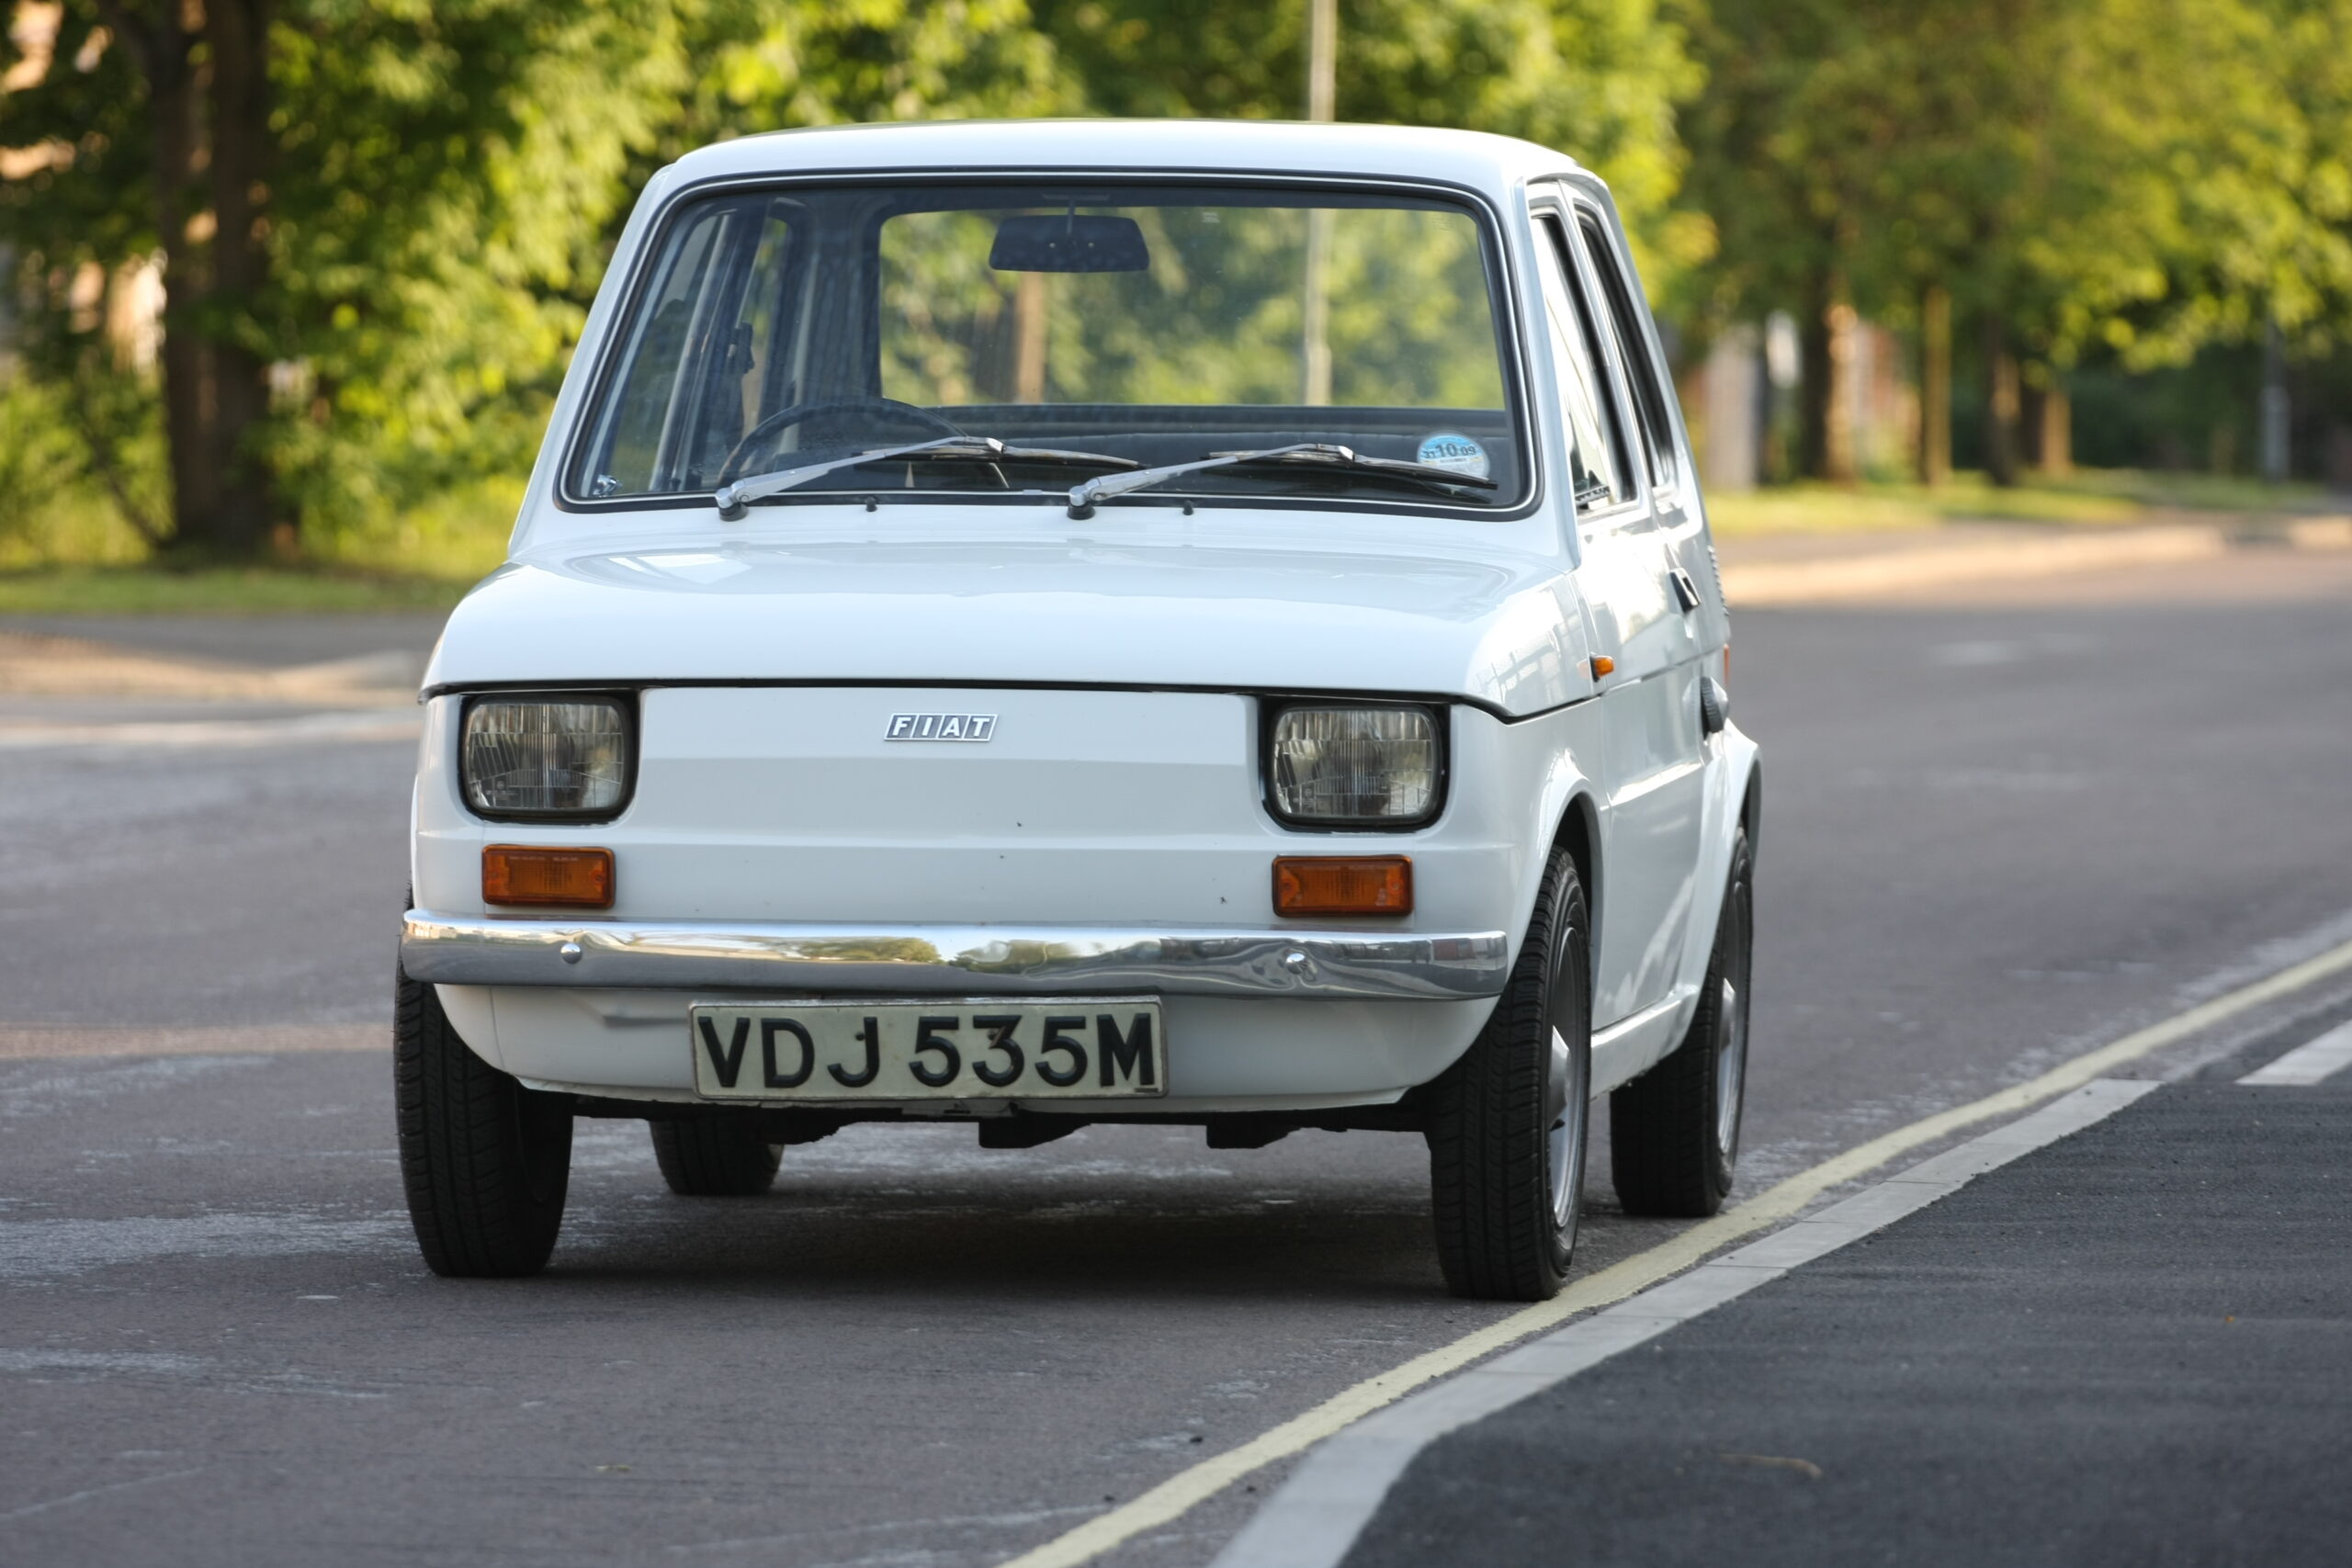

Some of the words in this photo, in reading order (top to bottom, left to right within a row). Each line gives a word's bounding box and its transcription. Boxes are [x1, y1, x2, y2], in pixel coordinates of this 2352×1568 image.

[1435, 443, 1457, 457] 10
[1462, 446, 1476, 456] 09
[892, 717, 990, 737] FIAT
[697, 1015, 880, 1088] VDJ
[909, 1013, 1156, 1088] 535M
